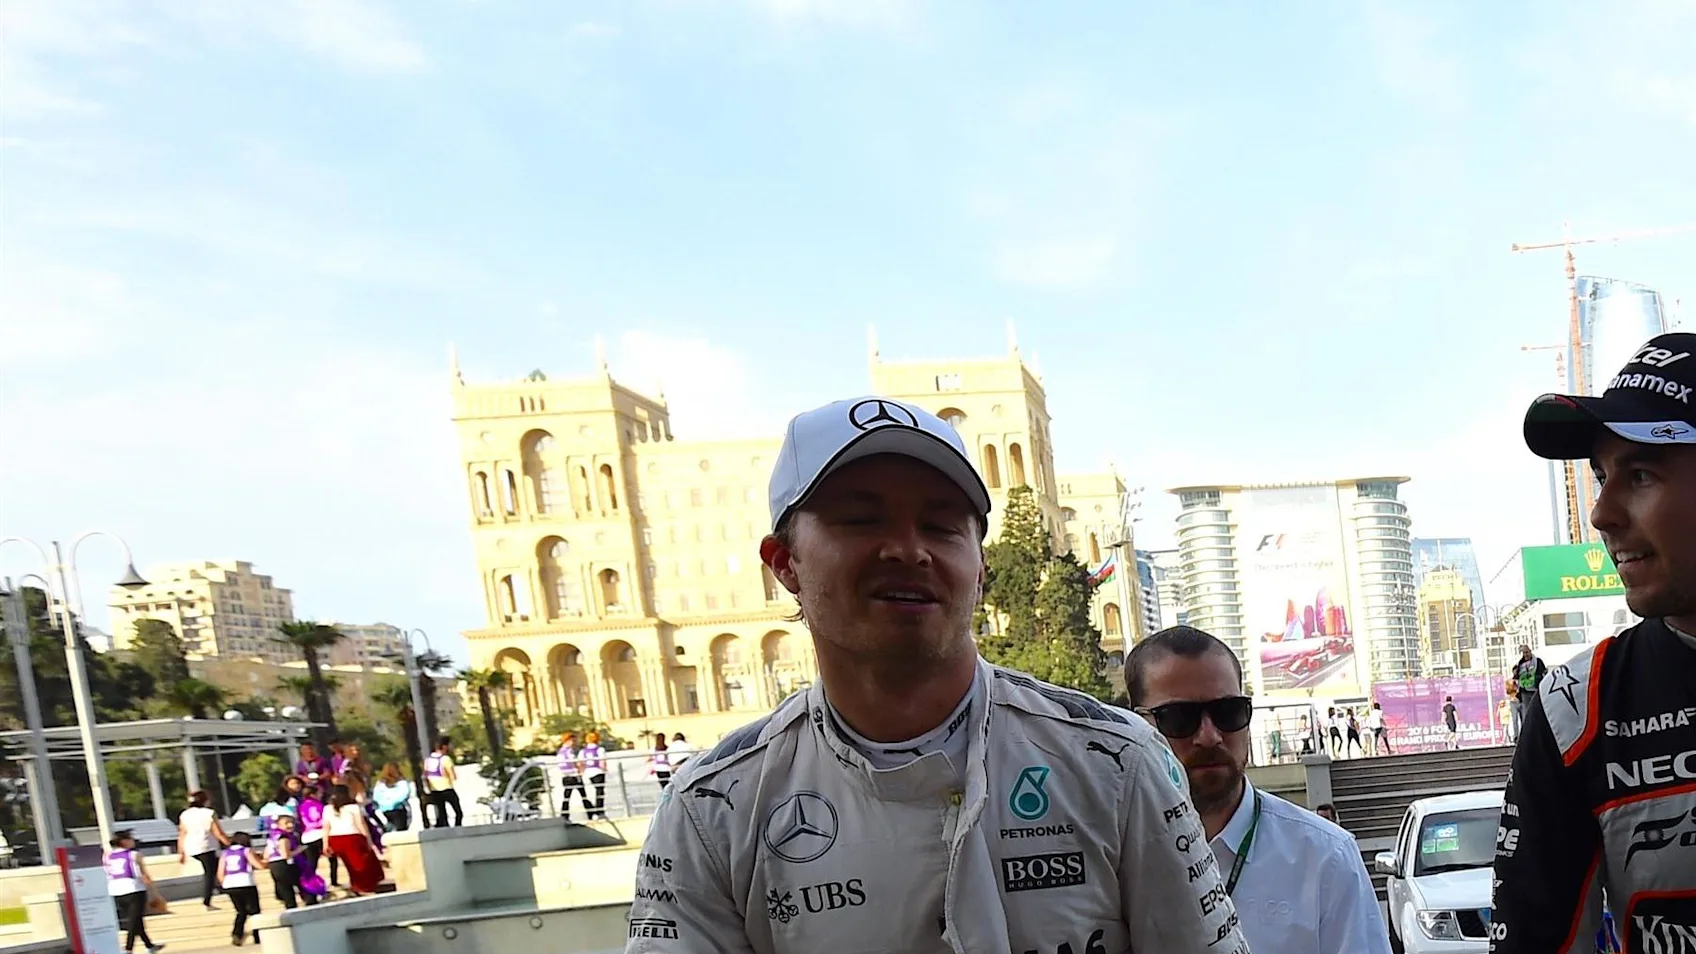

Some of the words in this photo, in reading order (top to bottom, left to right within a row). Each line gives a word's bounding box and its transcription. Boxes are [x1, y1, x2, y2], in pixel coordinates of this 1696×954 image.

[1628, 342, 1690, 368] cel
[1608, 373, 1693, 405] anamex
[1561, 575, 1624, 592] ROLE
[1000, 824, 1074, 839] PETRONAS
[1006, 855, 1082, 881] BOSS
[799, 879, 866, 914] UBS
